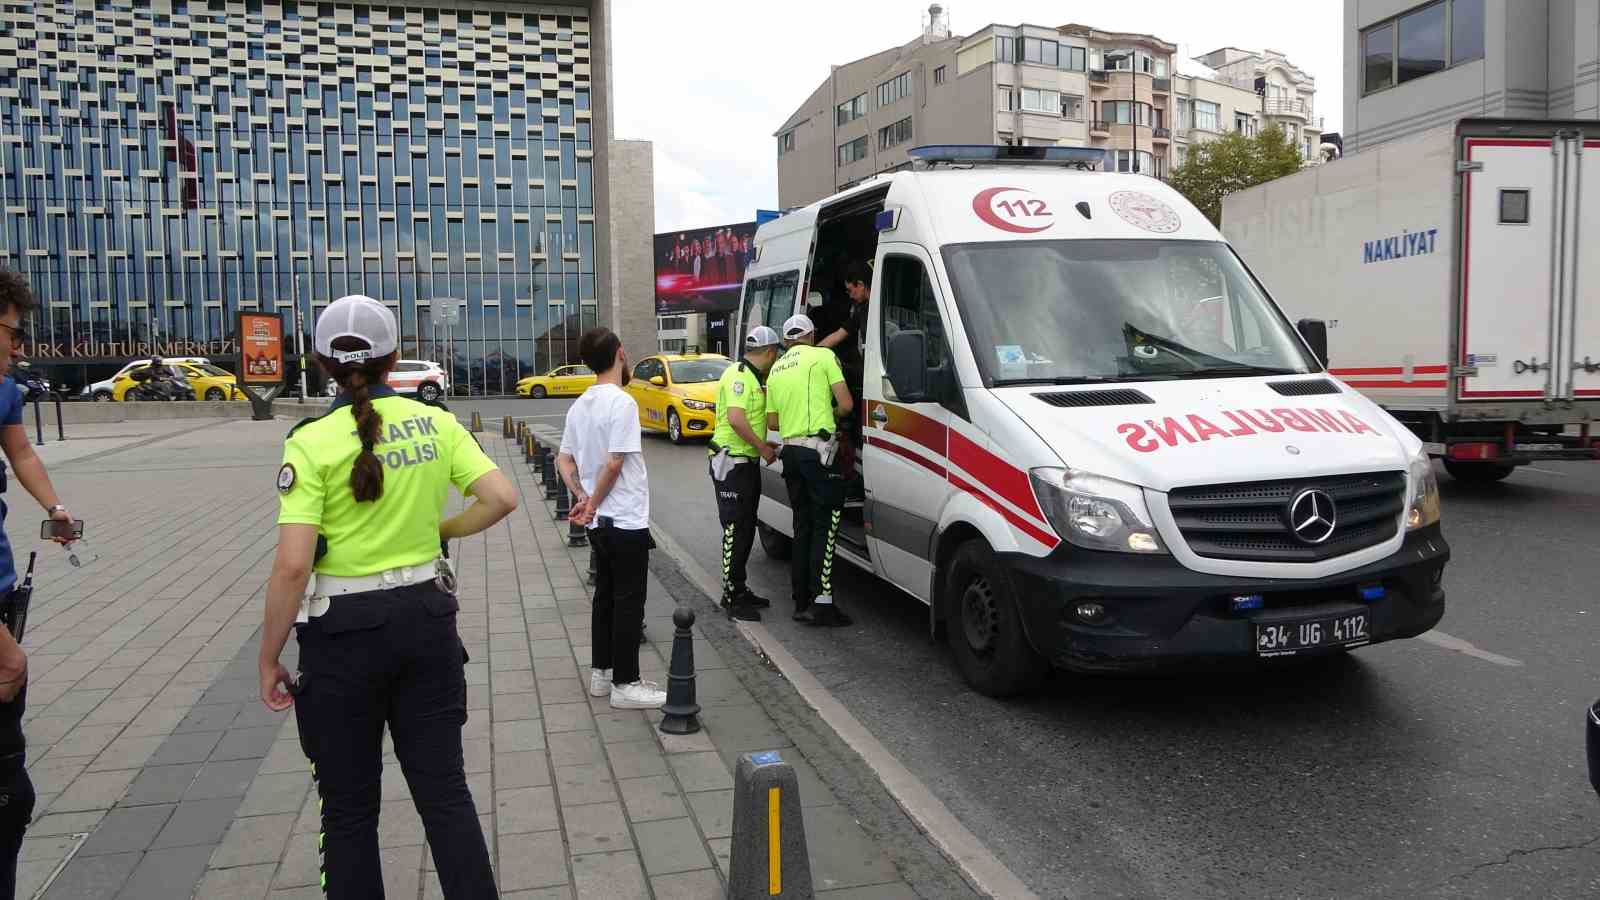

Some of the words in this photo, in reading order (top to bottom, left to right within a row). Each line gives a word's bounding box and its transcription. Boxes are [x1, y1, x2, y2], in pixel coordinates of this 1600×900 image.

[997, 199, 1053, 217] 112
[1363, 229, 1438, 264] NAKLİYAT
[1266, 625, 1288, 648] 34
[1299, 623, 1321, 646] UG
[1333, 615, 1365, 641] 4112
